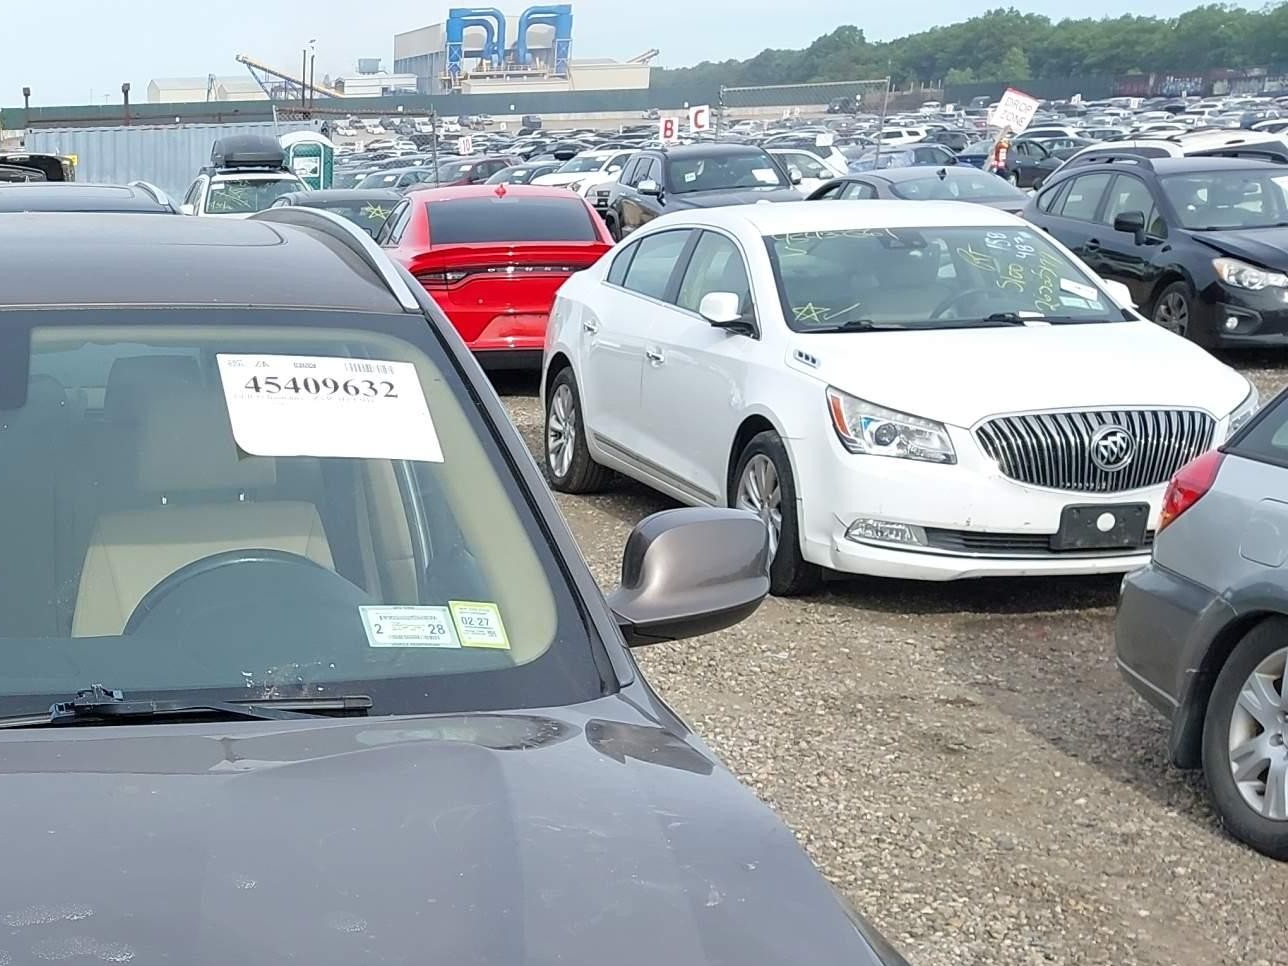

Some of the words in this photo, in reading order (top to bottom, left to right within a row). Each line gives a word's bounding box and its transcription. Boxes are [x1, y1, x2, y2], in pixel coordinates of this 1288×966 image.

[1004, 96, 1033, 114] DROP
[693, 109, 705, 129] C
[1000, 109, 1026, 127] ZONE
[663, 119, 674, 139] B
[243, 375, 399, 399] 45409632
[373, 623, 384, 635] 2
[427, 623, 446, 636] 28
